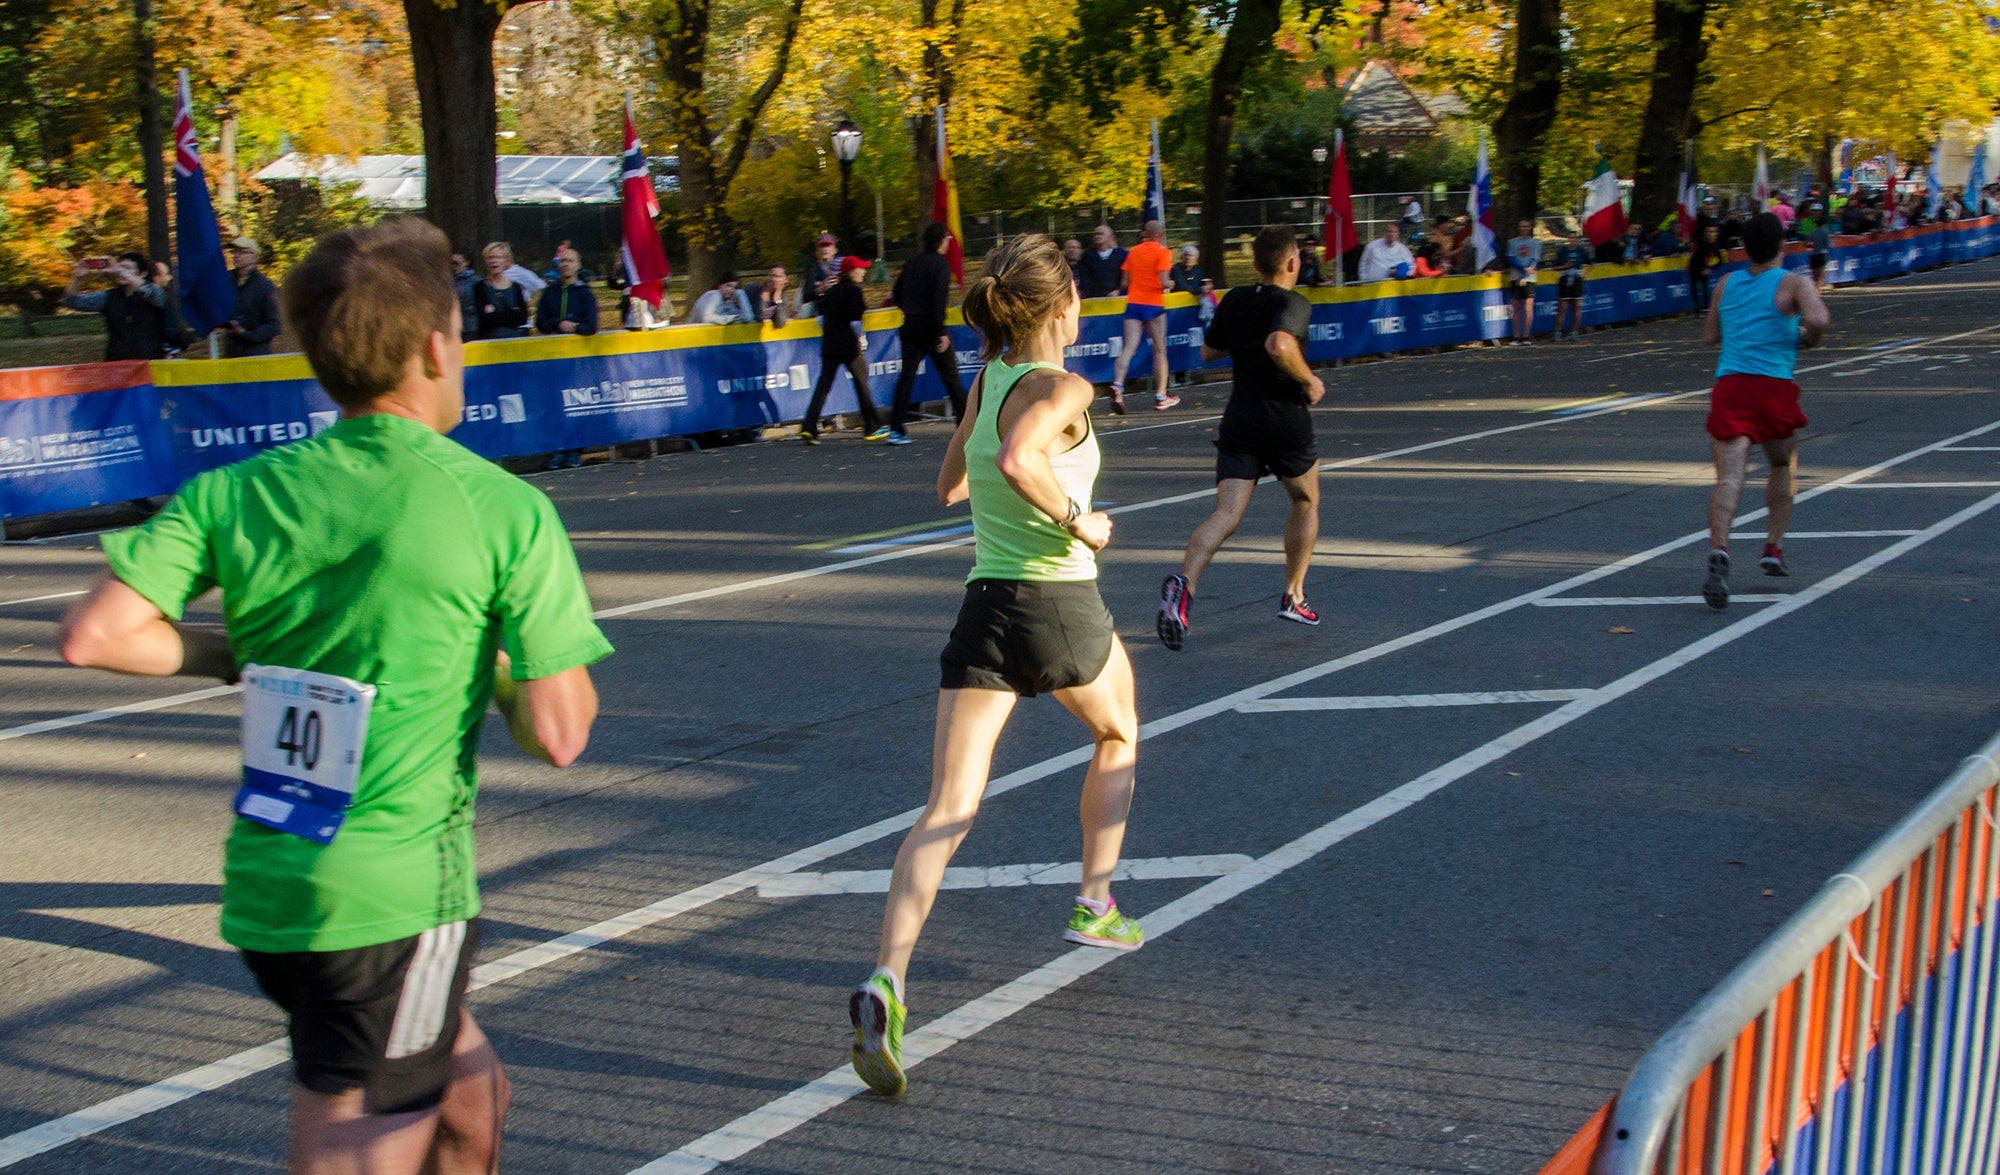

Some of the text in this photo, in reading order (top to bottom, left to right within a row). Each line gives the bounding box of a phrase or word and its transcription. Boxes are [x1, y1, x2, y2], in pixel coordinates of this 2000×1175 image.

[1368, 315, 1407, 335] TIMEX
[717, 373, 789, 395] UNITED
[561, 386, 601, 407] ING
[191, 421, 308, 448] UNITED
[41, 434, 140, 461] MARATHON
[277, 706, 321, 771] 40
